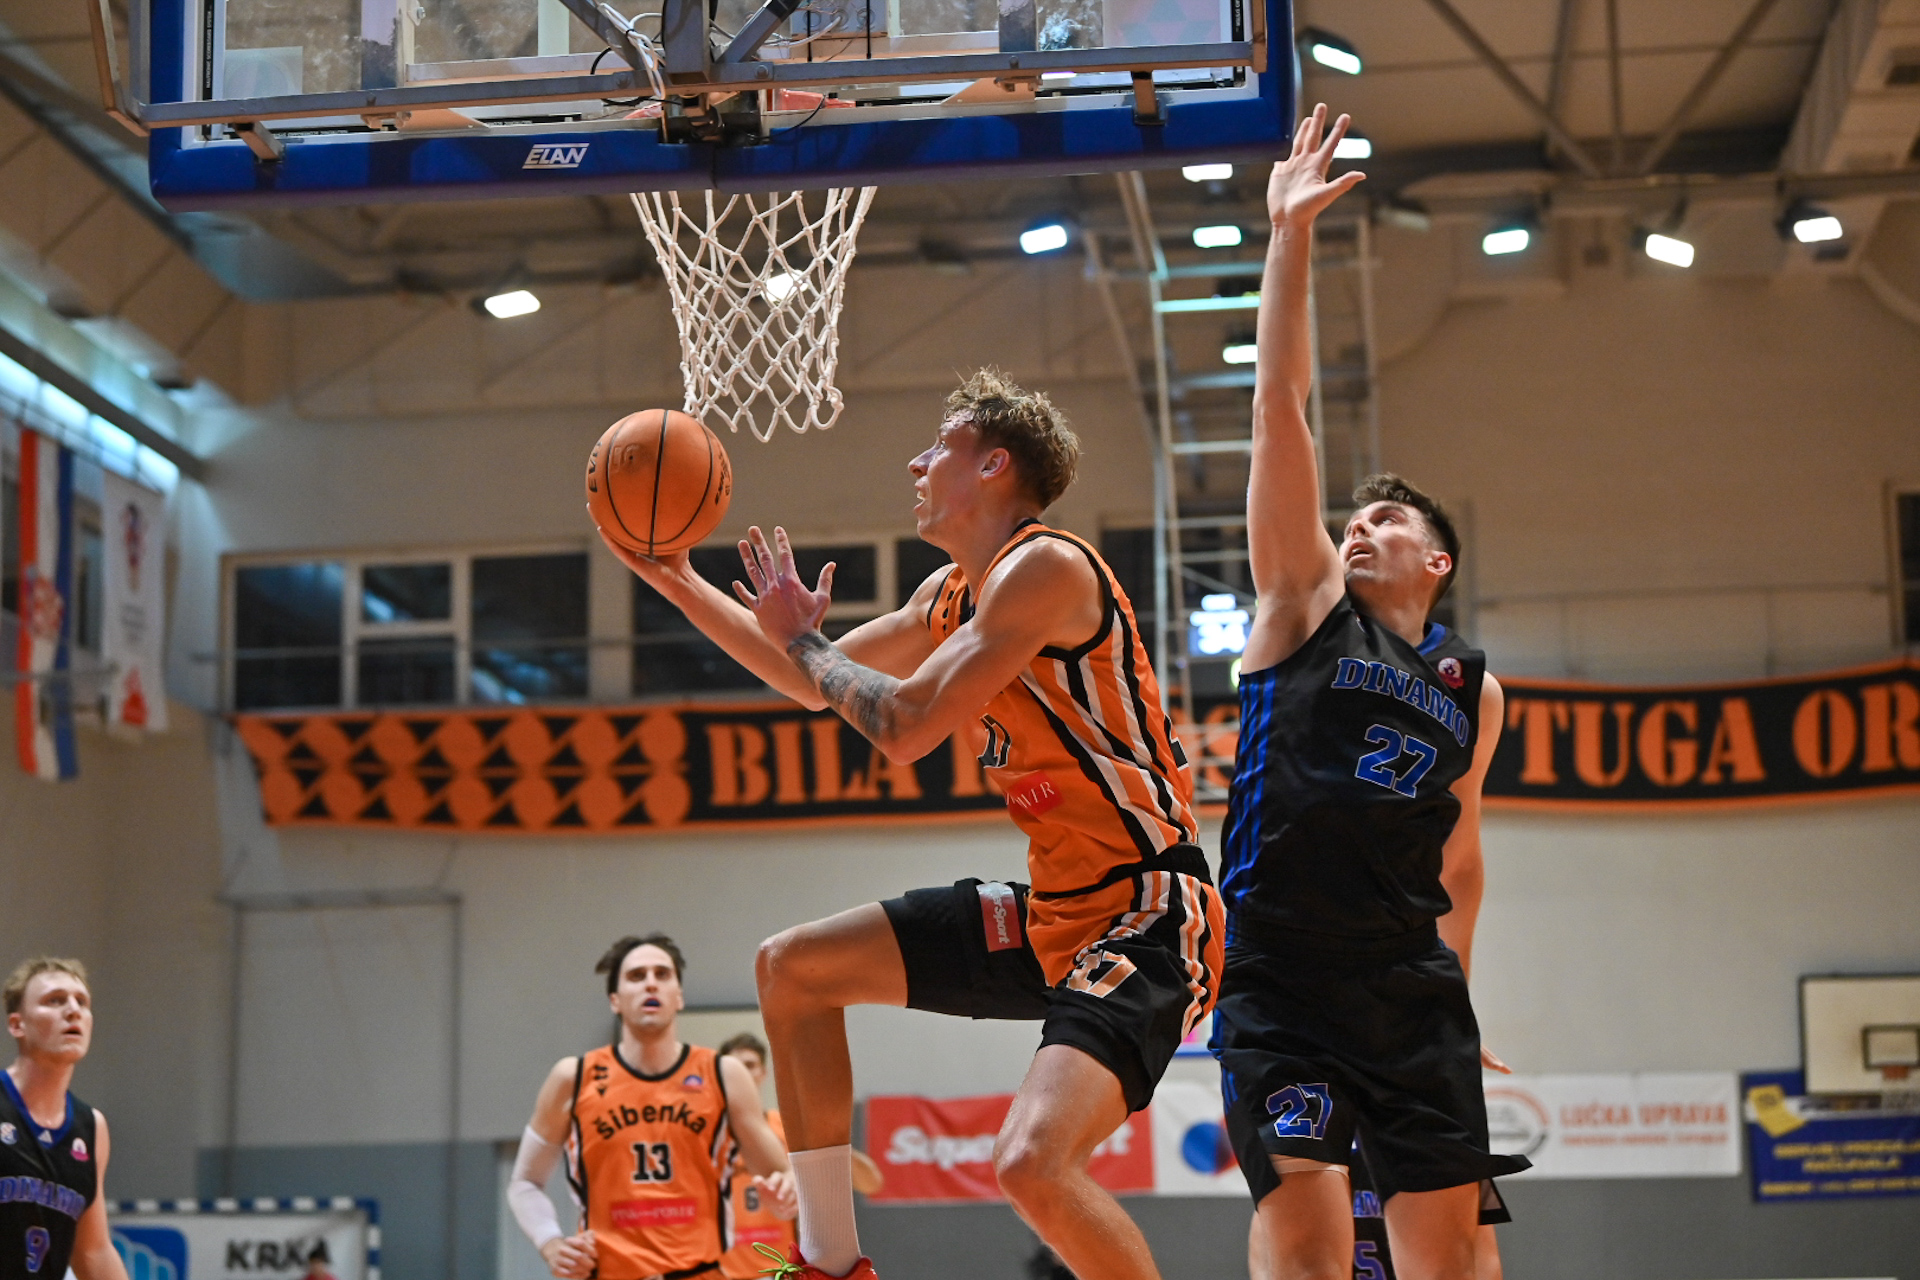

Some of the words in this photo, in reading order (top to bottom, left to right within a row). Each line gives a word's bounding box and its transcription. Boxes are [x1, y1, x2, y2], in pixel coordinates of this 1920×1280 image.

[523, 146, 589, 165] ELAN
[1331, 657, 1470, 748] DINAMO
[706, 716, 923, 806] BILA
[1507, 697, 1767, 788] TUGA
[1354, 723, 1438, 799] 27
[1265, 1082, 1333, 1141] 27
[631, 1142, 674, 1184] 13
[26, 1226, 50, 1273] 9
[226, 1237, 330, 1272] KRKA
